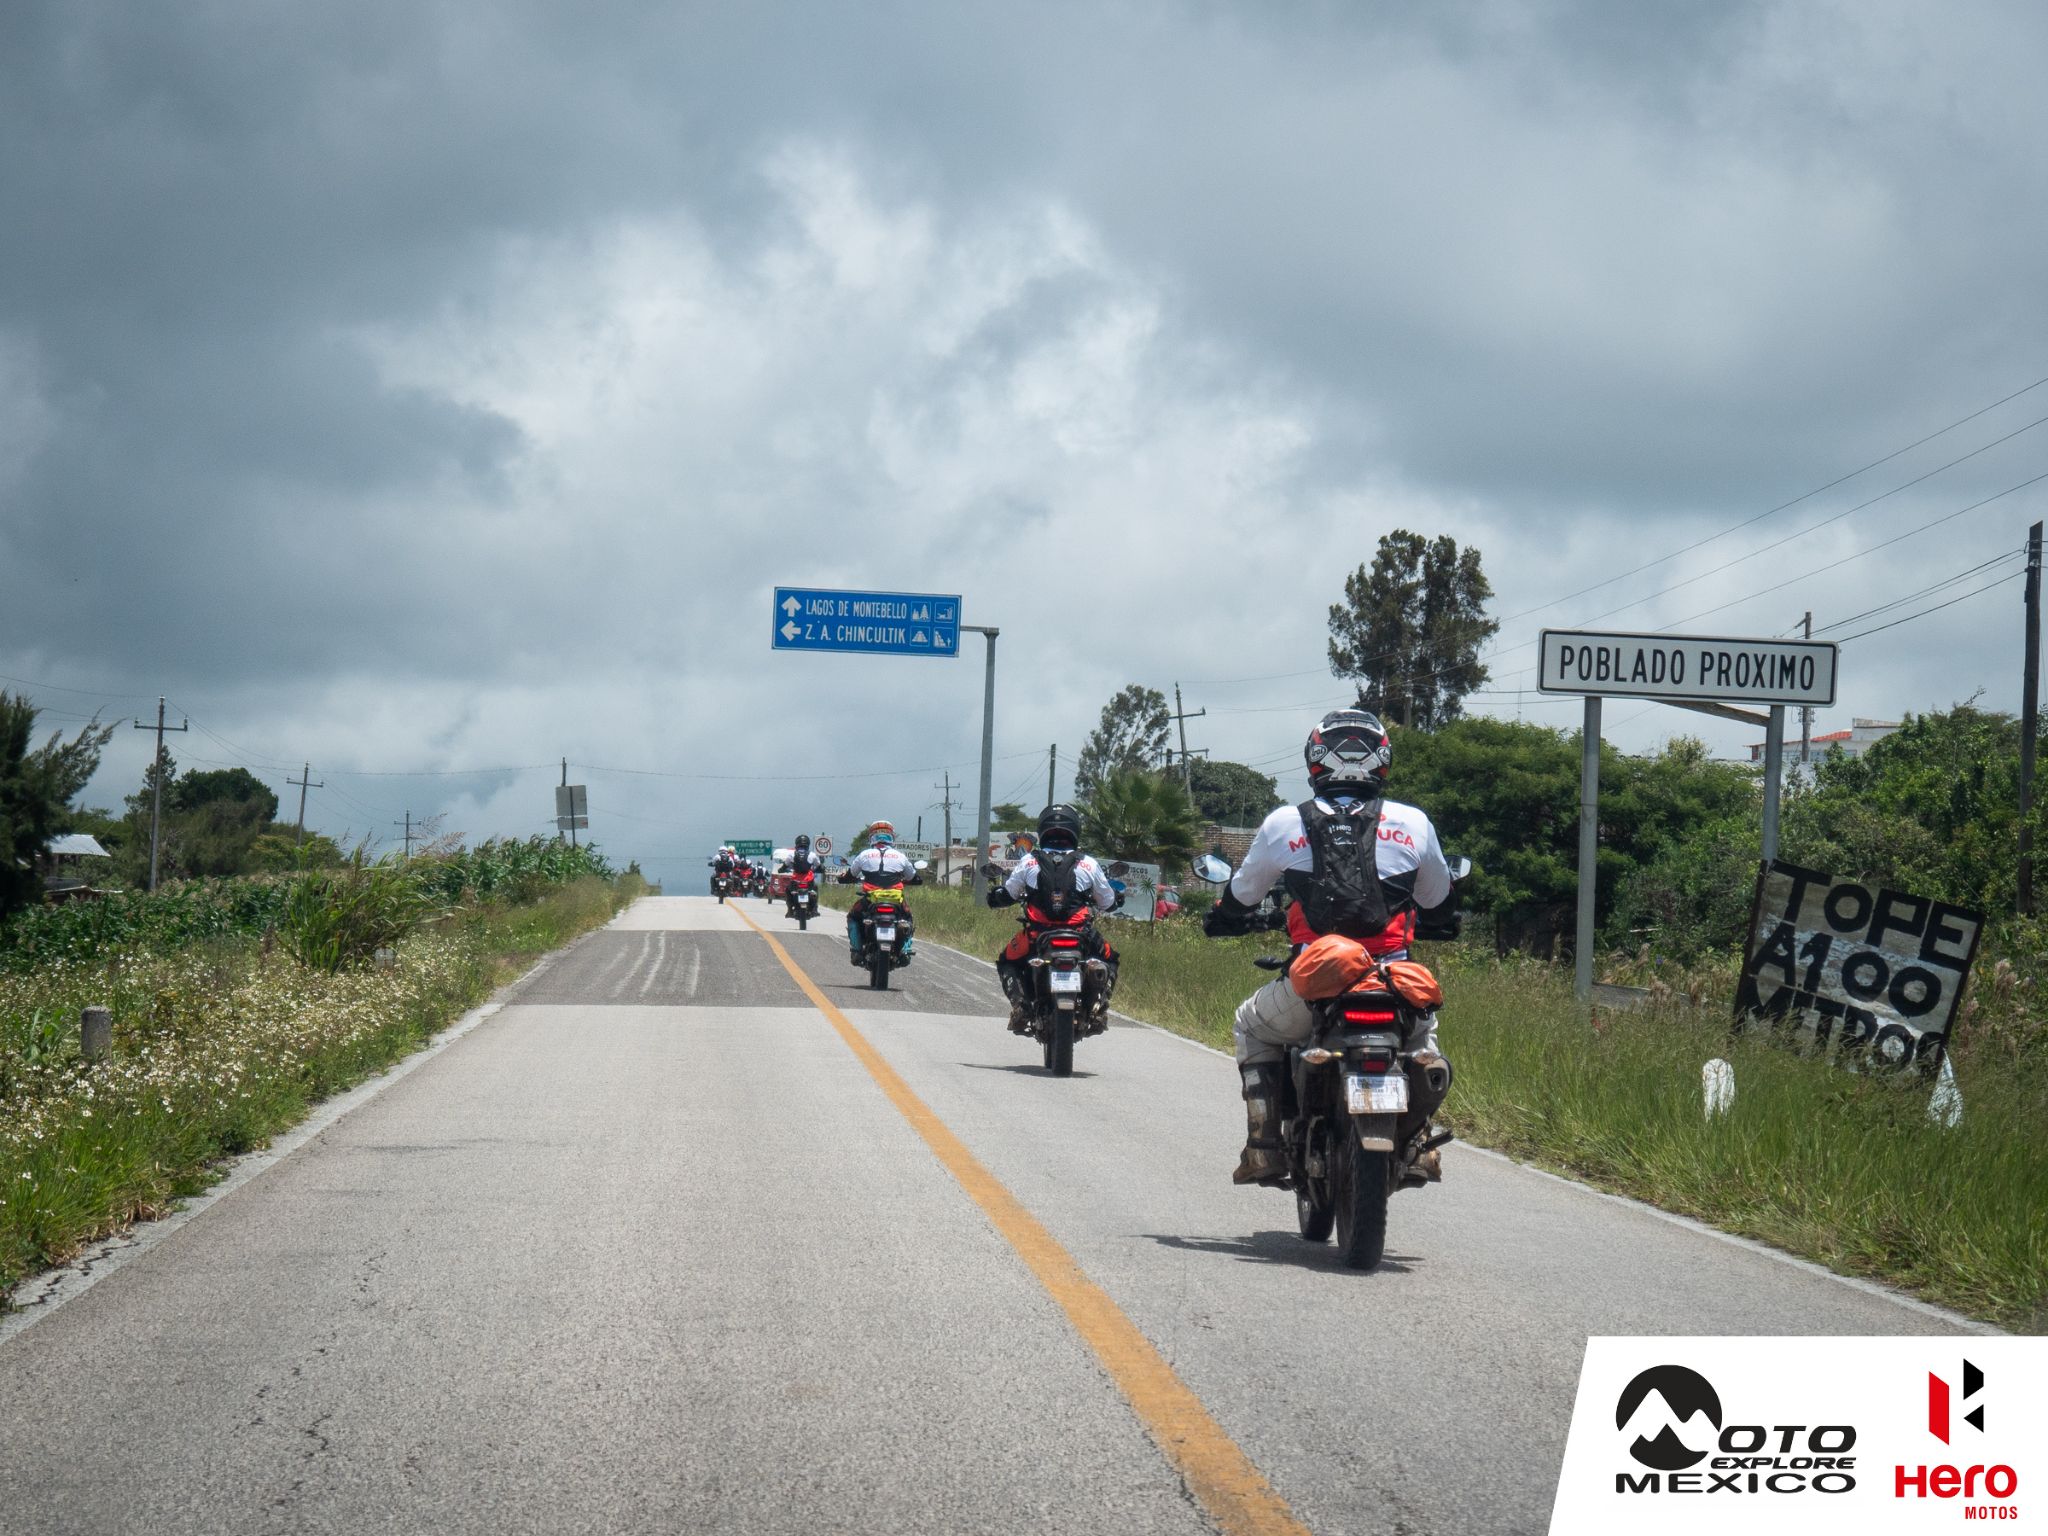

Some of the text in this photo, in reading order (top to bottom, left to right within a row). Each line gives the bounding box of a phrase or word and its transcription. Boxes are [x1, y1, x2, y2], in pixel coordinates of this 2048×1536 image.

[806, 599, 907, 619] LAGOS DE MONTEBELLO
[805, 624, 906, 644] Z. A. CHINCULTIK
[1560, 645, 1815, 691] POBLADO PROXIMO
[818, 841, 829, 849] 60
[896, 843, 930, 851] IBRADORES
[1770, 859, 1985, 972] TOPE
